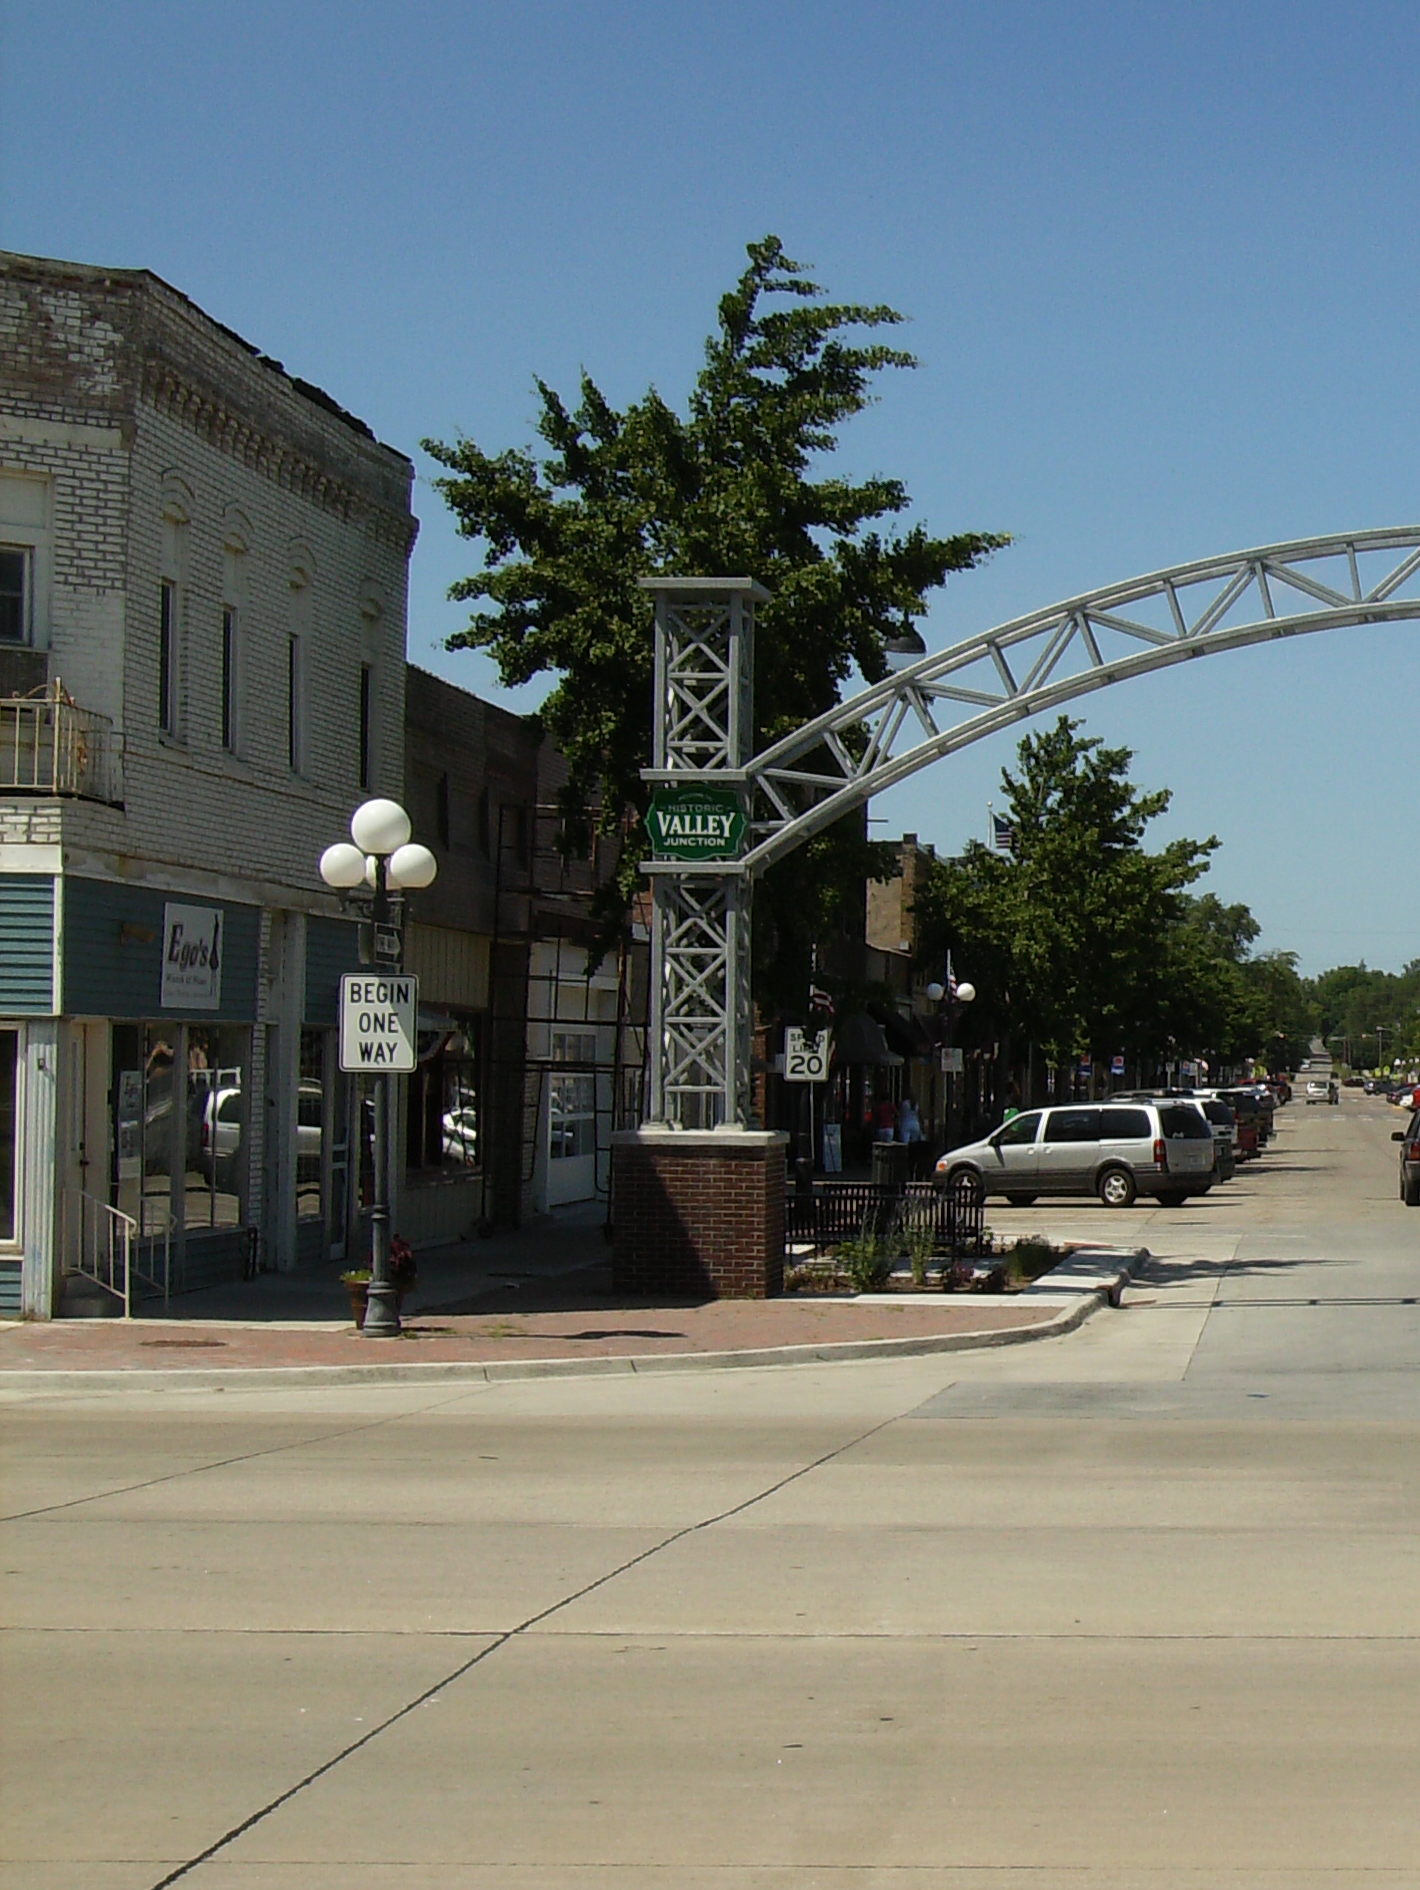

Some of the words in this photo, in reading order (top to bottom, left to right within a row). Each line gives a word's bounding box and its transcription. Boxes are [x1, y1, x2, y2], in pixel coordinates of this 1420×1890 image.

[668, 804, 724, 813] HISTORIC
[656, 811, 736, 838] VALLEY
[663, 838, 726, 847] JUNCTION
[168, 924, 209, 972] Ego's
[350, 983, 409, 1004] BEGIN
[359, 1012, 399, 1034] ONE
[359, 1042, 398, 1063] WAY
[790, 1055, 823, 1075] 20
